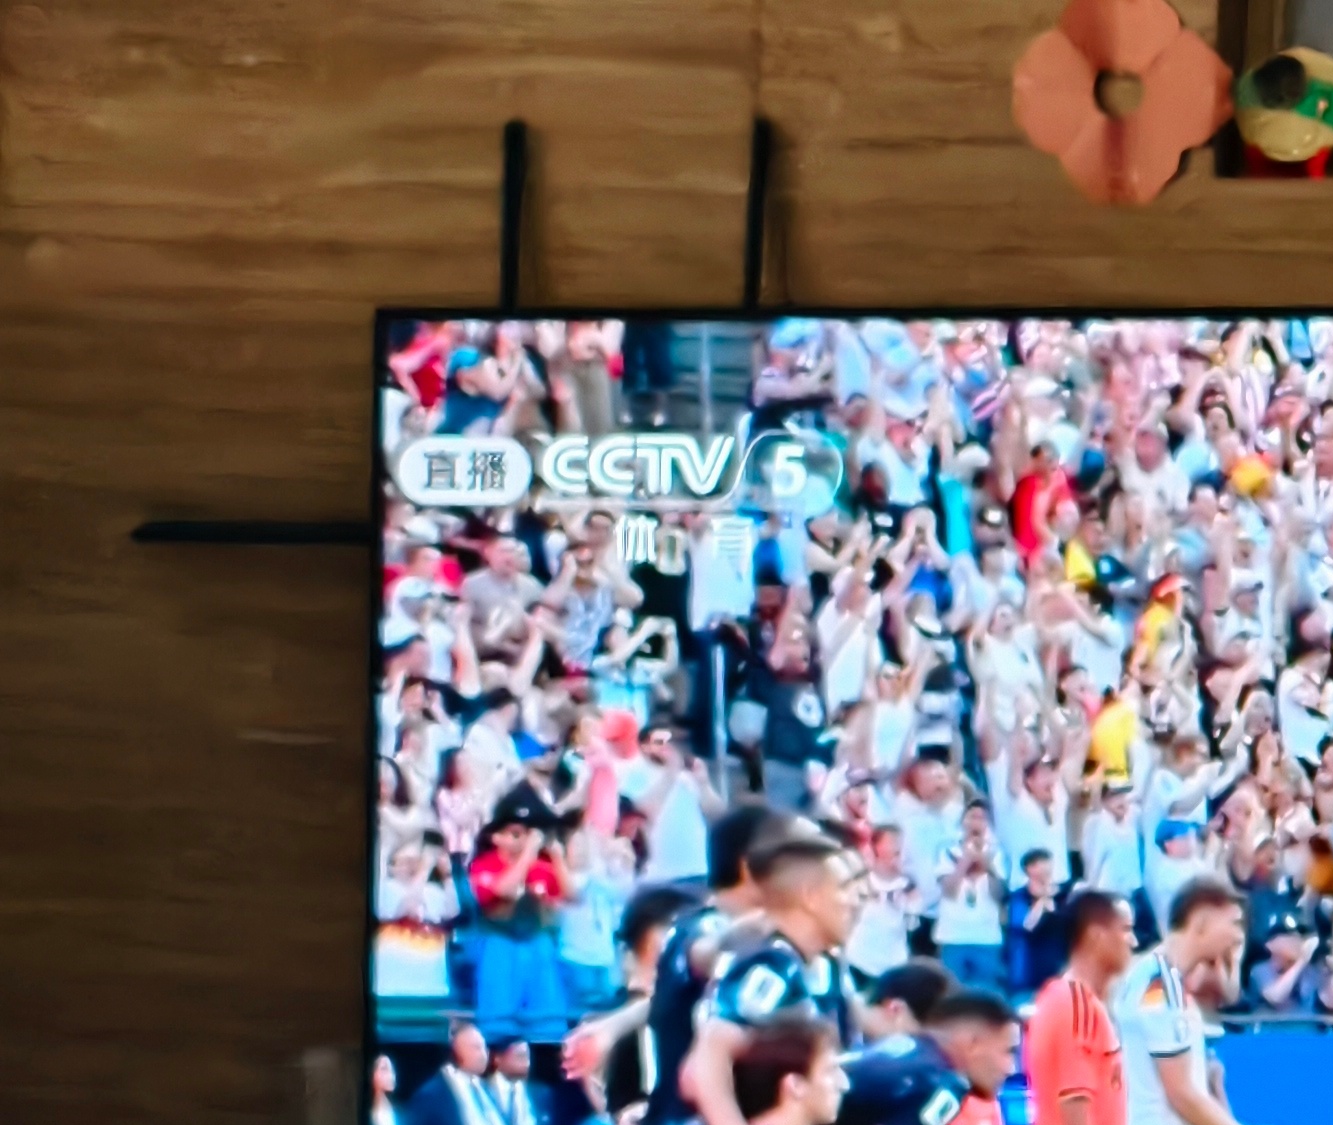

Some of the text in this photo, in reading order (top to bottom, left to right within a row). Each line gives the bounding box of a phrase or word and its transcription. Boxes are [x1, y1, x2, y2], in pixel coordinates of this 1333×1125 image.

[424, 450, 507, 492] 直播
[543, 436, 806, 496] CCTV 5
